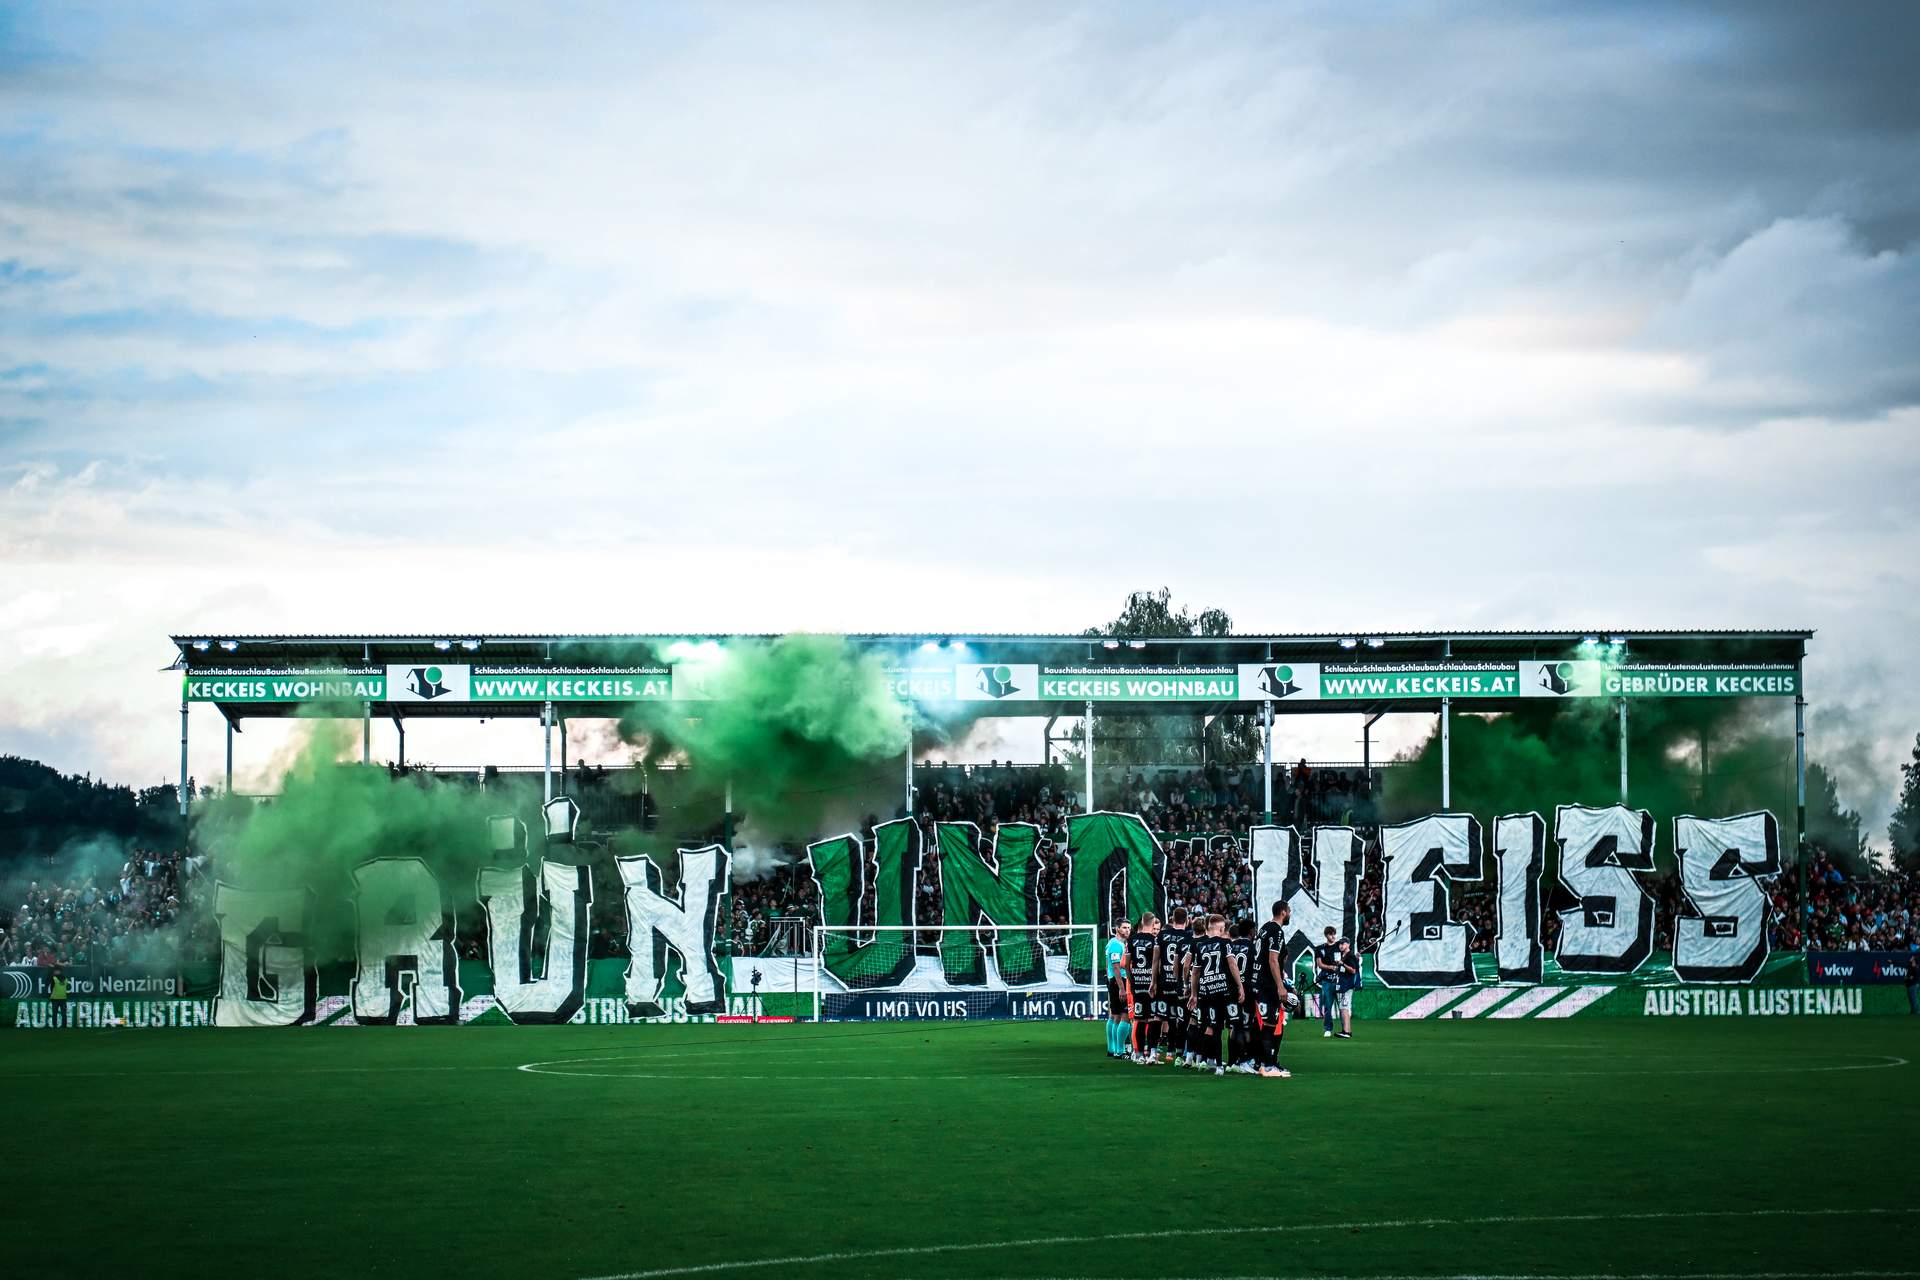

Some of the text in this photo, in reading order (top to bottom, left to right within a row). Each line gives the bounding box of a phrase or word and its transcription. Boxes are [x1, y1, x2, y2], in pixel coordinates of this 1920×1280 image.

[188, 681, 383, 698] KECKEIS WOHNBAU
[474, 680, 668, 697] WWW.KECKEIS.AT
[1043, 680, 1235, 697] KECKEIS WOHNBAU
[1324, 676, 1516, 695] WWW.KECKEIS.AT
[1605, 672, 1795, 693] GEBRÜDER KECKEIS
[1249, 803, 1782, 988] WEISS
[1136, 946, 1147, 968] 5
[1202, 950, 1221, 976] 27
[1824, 966, 1854, 977] vkw
[100, 975, 176, 995] Nenzing
[1643, 988, 1863, 1015] AUSTRIA LUSTENAU
